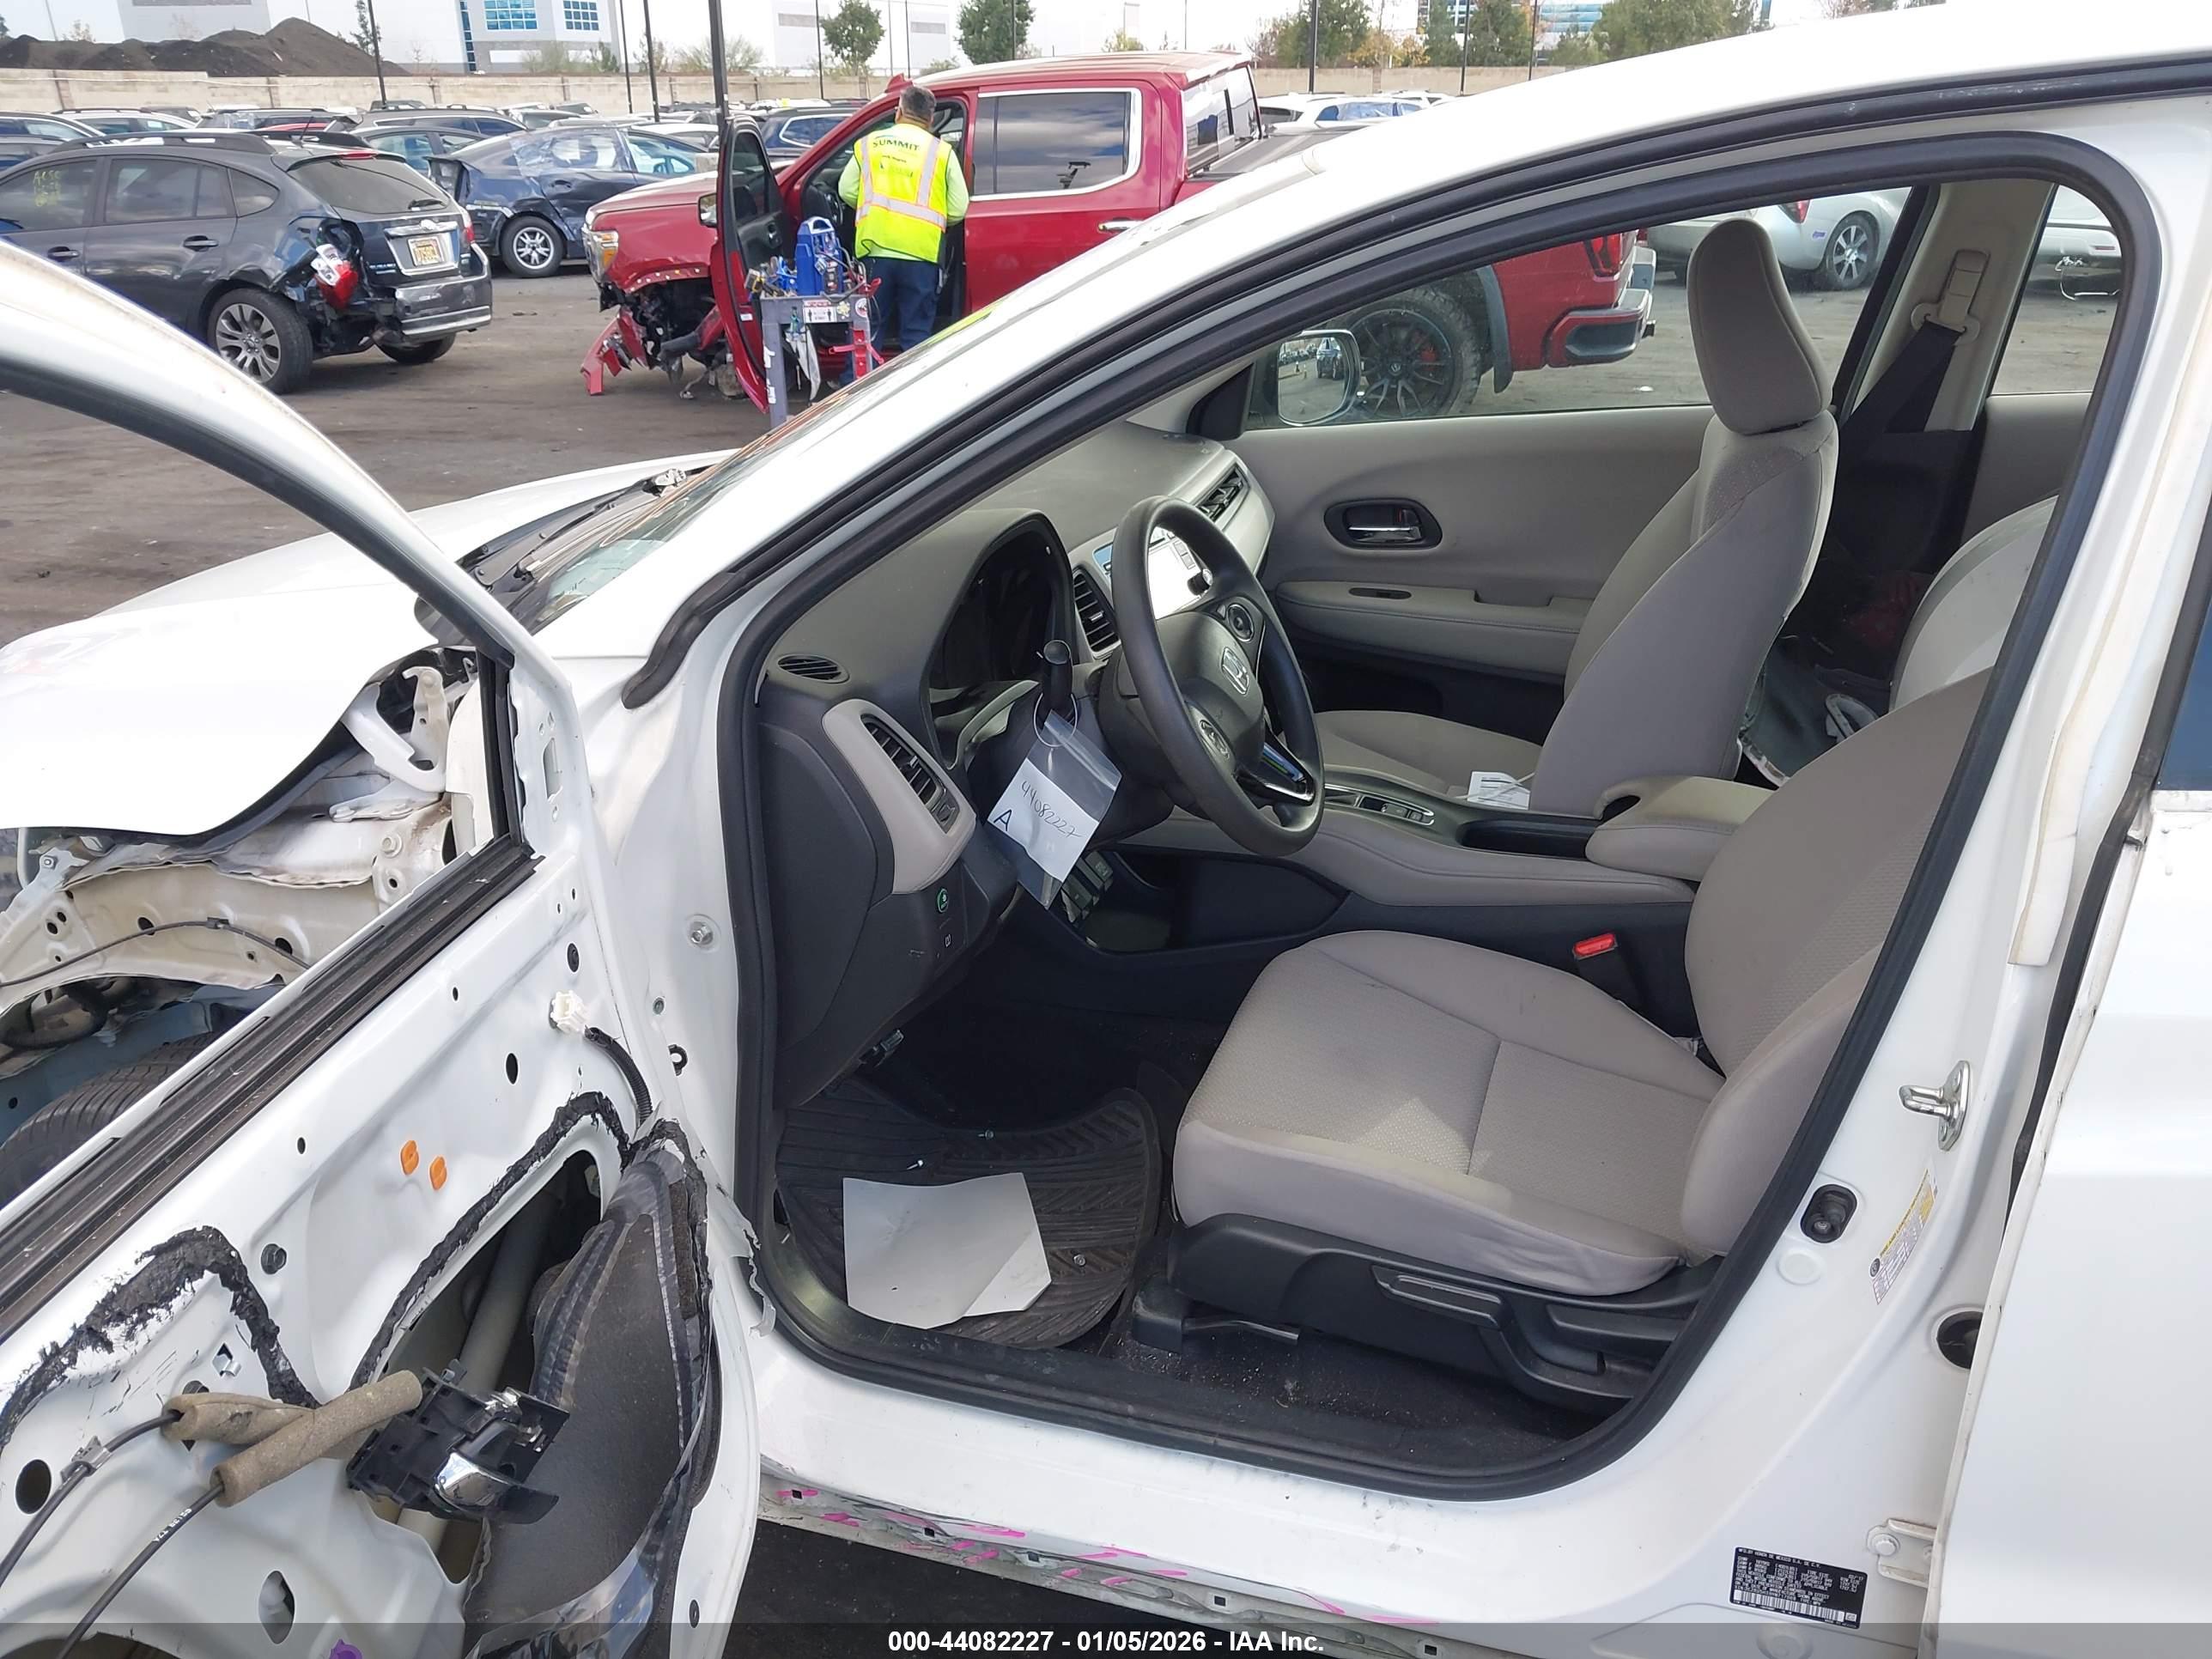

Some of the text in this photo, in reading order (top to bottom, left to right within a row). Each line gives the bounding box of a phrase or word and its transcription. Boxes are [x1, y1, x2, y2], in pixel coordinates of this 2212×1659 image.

[872, 139, 920, 150] SUMMIT
[1022, 781, 1081, 838] 44082227
[994, 810, 1012, 832] A
